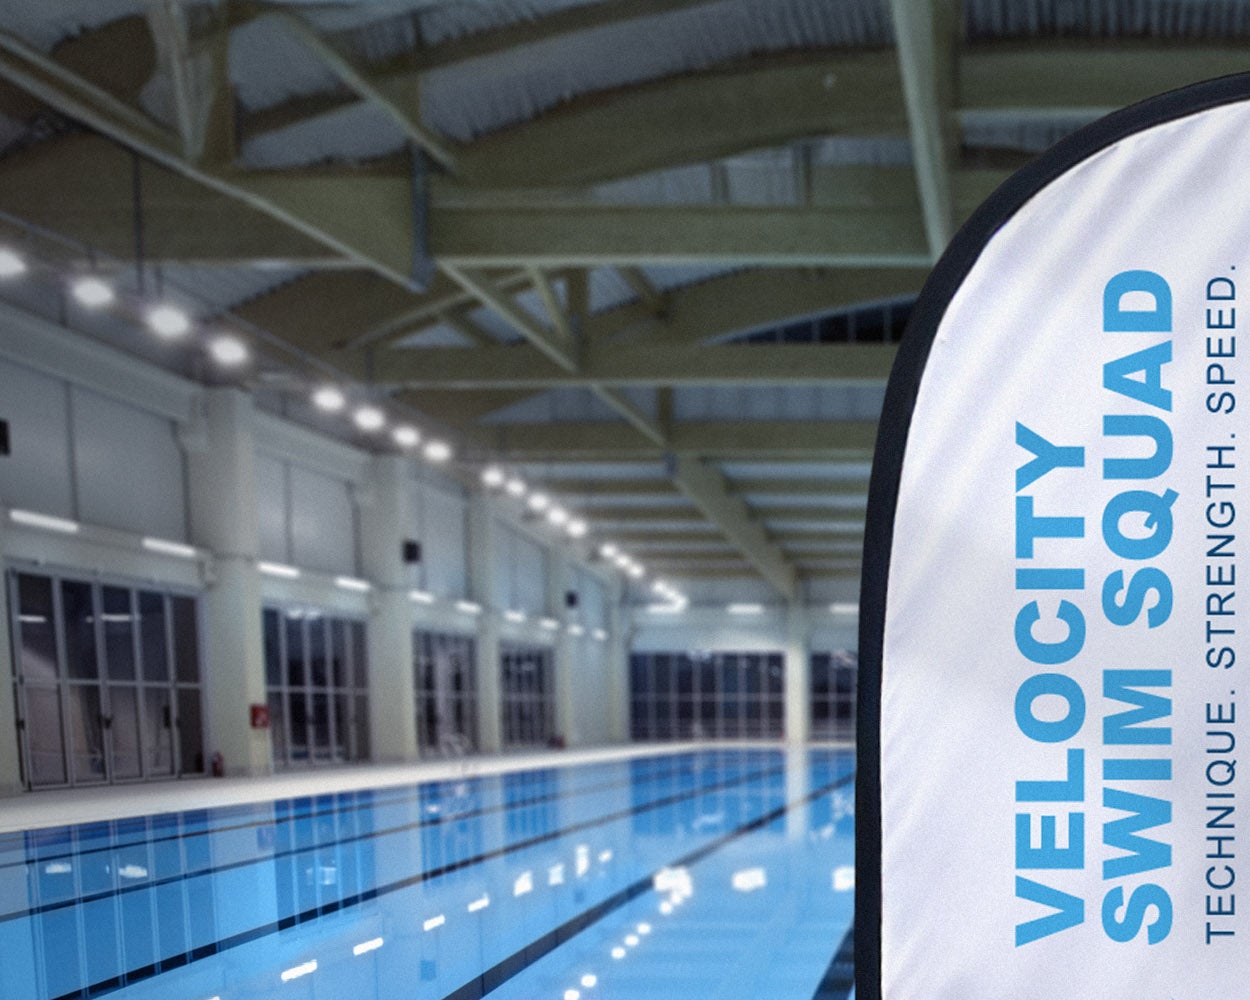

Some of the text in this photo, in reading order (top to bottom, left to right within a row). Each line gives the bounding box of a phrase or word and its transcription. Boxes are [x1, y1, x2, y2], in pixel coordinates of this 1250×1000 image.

[1014, 422, 1086, 947] VELOCITY
[1102, 270, 1179, 946] SWIM SQUAD
[1206, 266, 1237, 946] TECHNIQUE. STRENGTH. SPEED.
